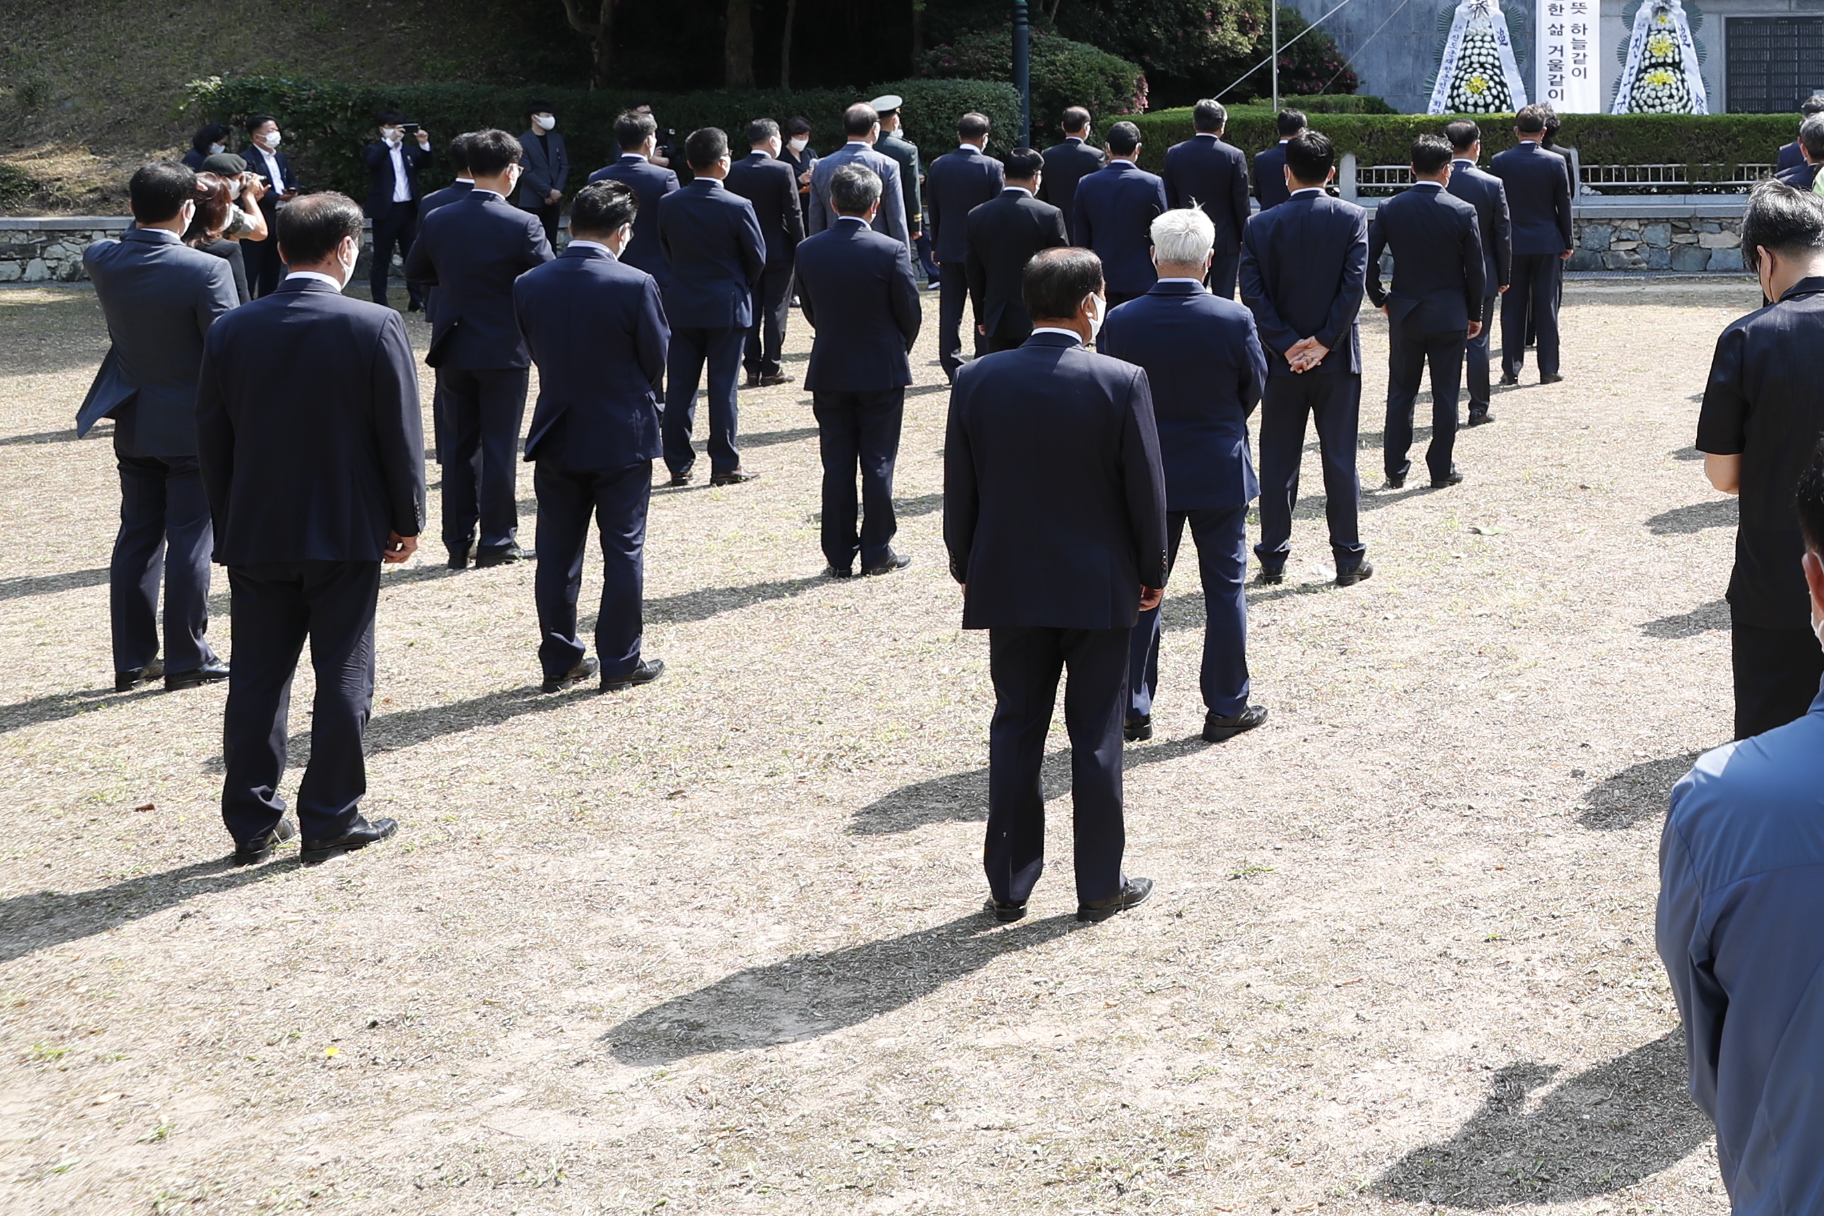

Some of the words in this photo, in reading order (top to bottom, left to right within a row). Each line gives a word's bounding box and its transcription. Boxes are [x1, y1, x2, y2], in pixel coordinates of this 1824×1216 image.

[1570, 2, 1588, 15] 뜻
[1547, 23, 1565, 36] 삶
[1570, 23, 1588, 80] 하늘같이
[1547, 45, 1566, 101] 거울같이
